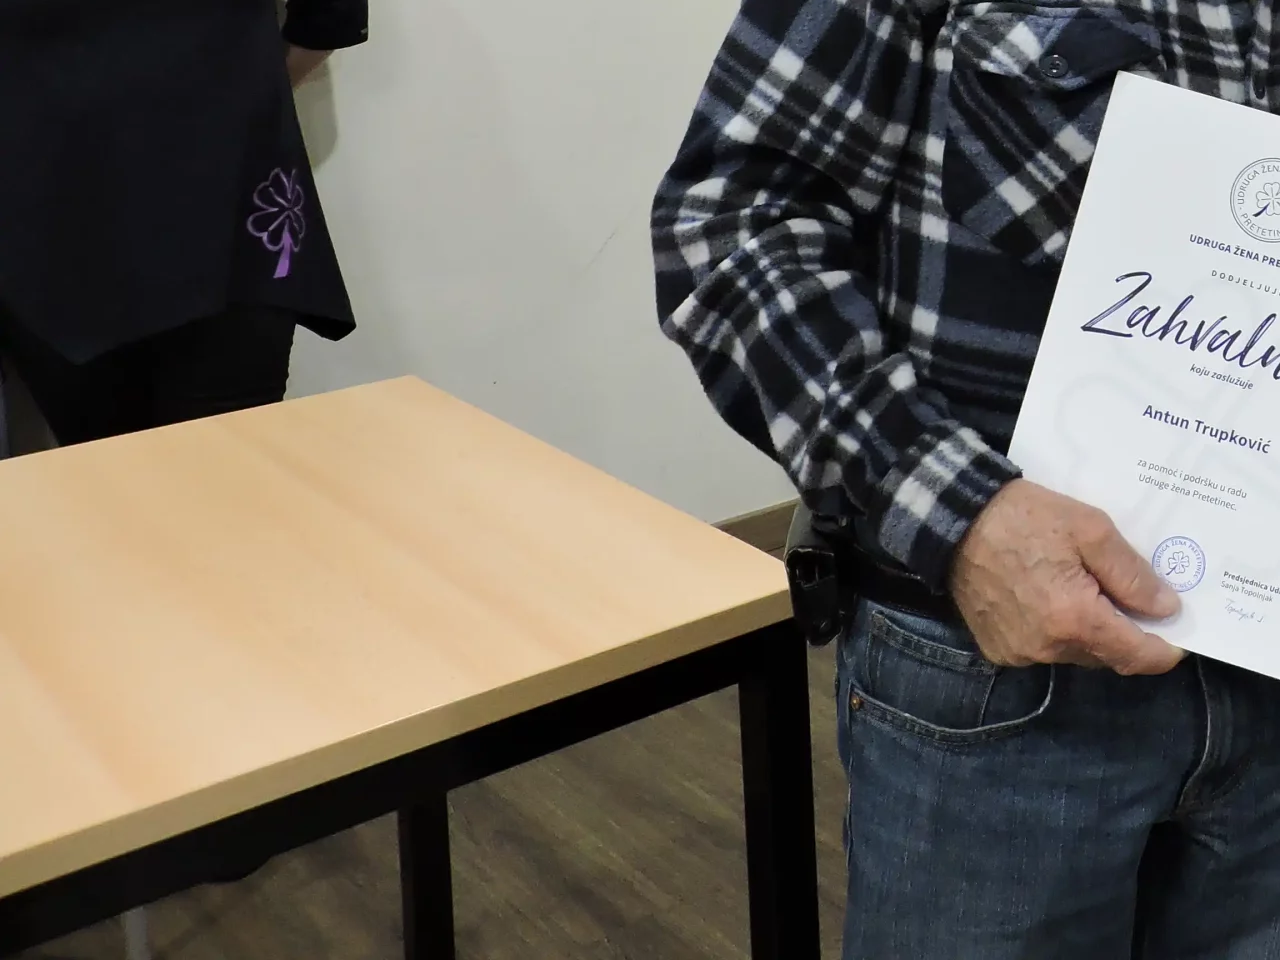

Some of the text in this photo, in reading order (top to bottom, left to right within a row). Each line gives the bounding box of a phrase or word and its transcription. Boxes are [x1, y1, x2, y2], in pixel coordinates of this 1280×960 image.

[1237, 169, 1260, 205] UDRUGA
[1189, 233, 1232, 254] UDRUGA
[1233, 245, 1260, 262] ŽENA
[1189, 363, 1254, 390] koju zaslužuje
[1142, 404, 1272, 454] Antun Trupković
[1137, 459, 1147, 468] za
[1148, 462, 1179, 478] pomoć
[1183, 473, 1219, 490] podršku
[1227, 487, 1248, 499] radu
[1138, 473, 1237, 511] Udruge žena Pretetinec.
[1220, 580, 1273, 602] Sanja Topolnjak
[1223, 570, 1269, 591] Predsjednica
